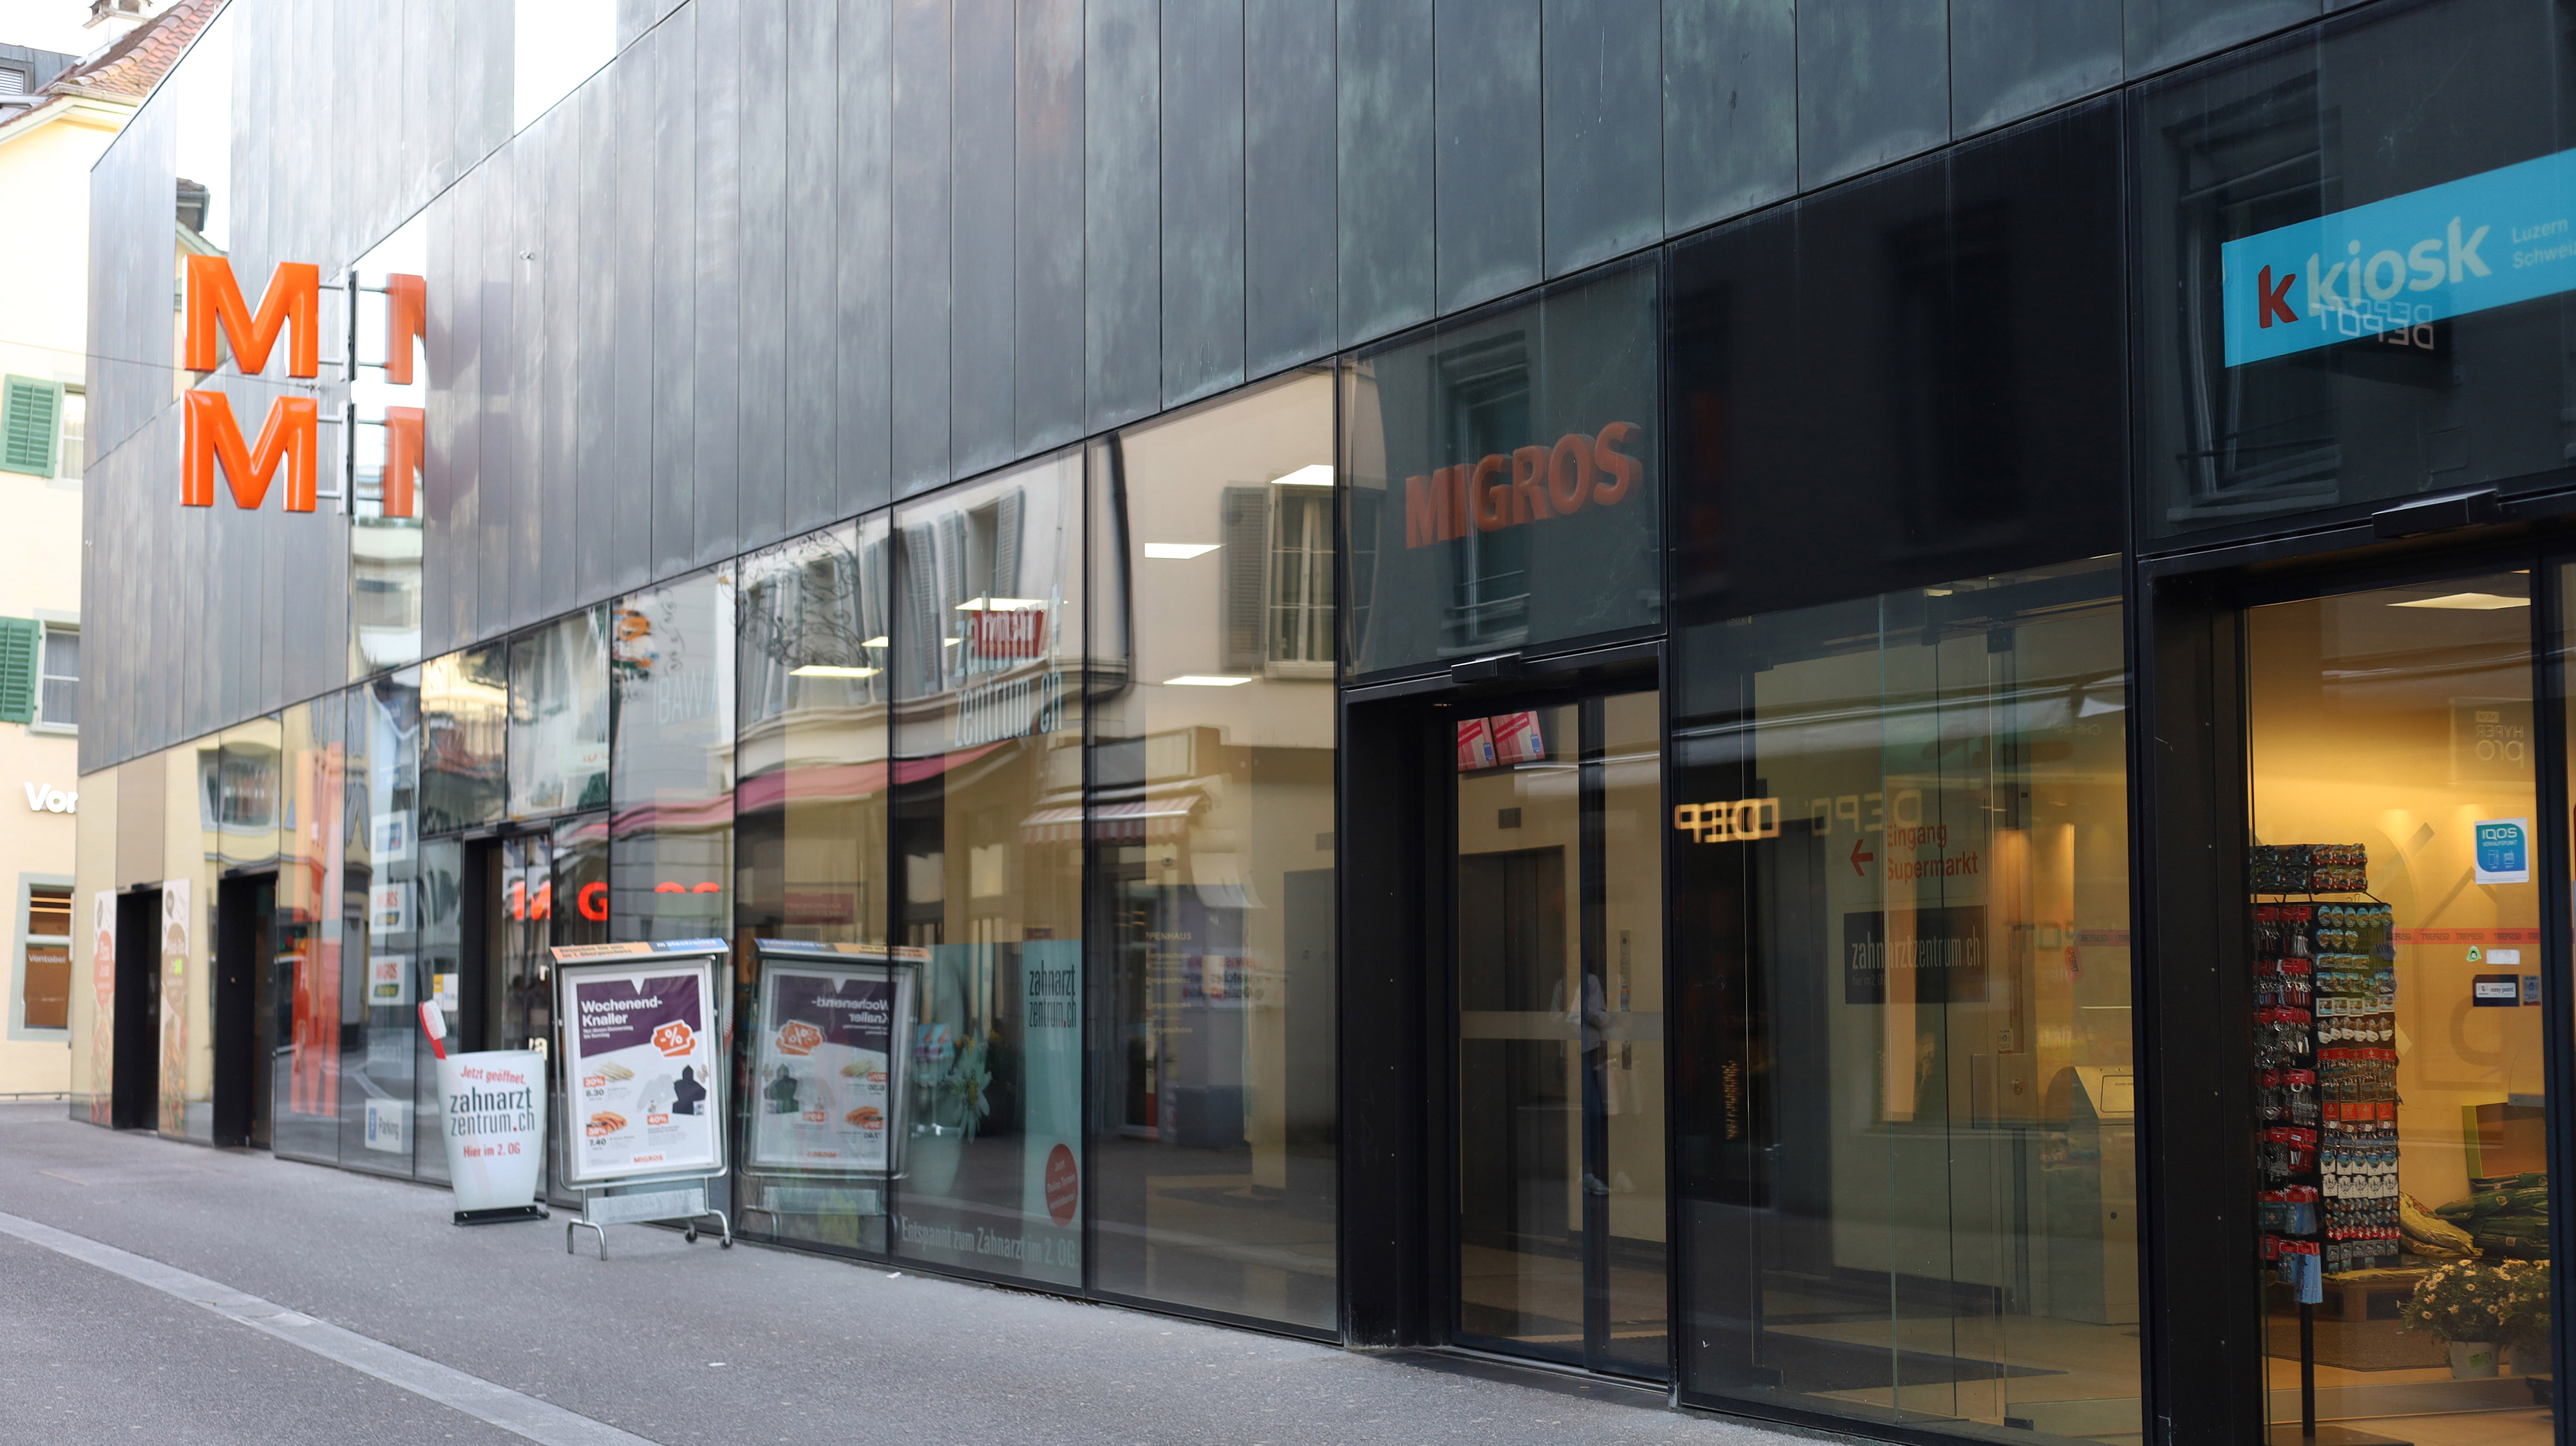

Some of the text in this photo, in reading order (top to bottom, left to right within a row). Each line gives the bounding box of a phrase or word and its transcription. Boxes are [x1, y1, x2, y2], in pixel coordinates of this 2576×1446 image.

[2512, 219, 2568, 243] Luzern
[2307, 216, 2492, 317] kiosk
[181, 254, 319, 379] M
[179, 390, 317, 512] M
[1405, 420, 1643, 549] MIGROS
[1887, 824, 1947, 850] Eingang
[2482, 827, 2517, 840] IQOS
[1888, 850, 1978, 884] Supermarkt
[1030, 959, 1075, 996] zahnarzt
[2502, 986, 2514, 994] point
[581, 995, 663, 1013] Wochenend-
[1030, 998, 1076, 1028] zentrum.ch
[582, 1012, 629, 1027] Knaller
[460, 1065, 483, 1080] Jetzt
[585, 1078, 605, 1086] 30%
[450, 1086, 533, 1113] zahnarzt
[451, 1112, 535, 1136] zentrum.ch
[648, 1115, 667, 1123] 40%
[464, 1142, 521, 1158] Hier im 2. OG
[634, 1154, 663, 1163] MIGROS
[902, 1216, 951, 1251] Entspannt
[953, 1230, 975, 1252] zum
[977, 1226, 1025, 1261] Zahnarzt
[1028, 1234, 1042, 1263] im
